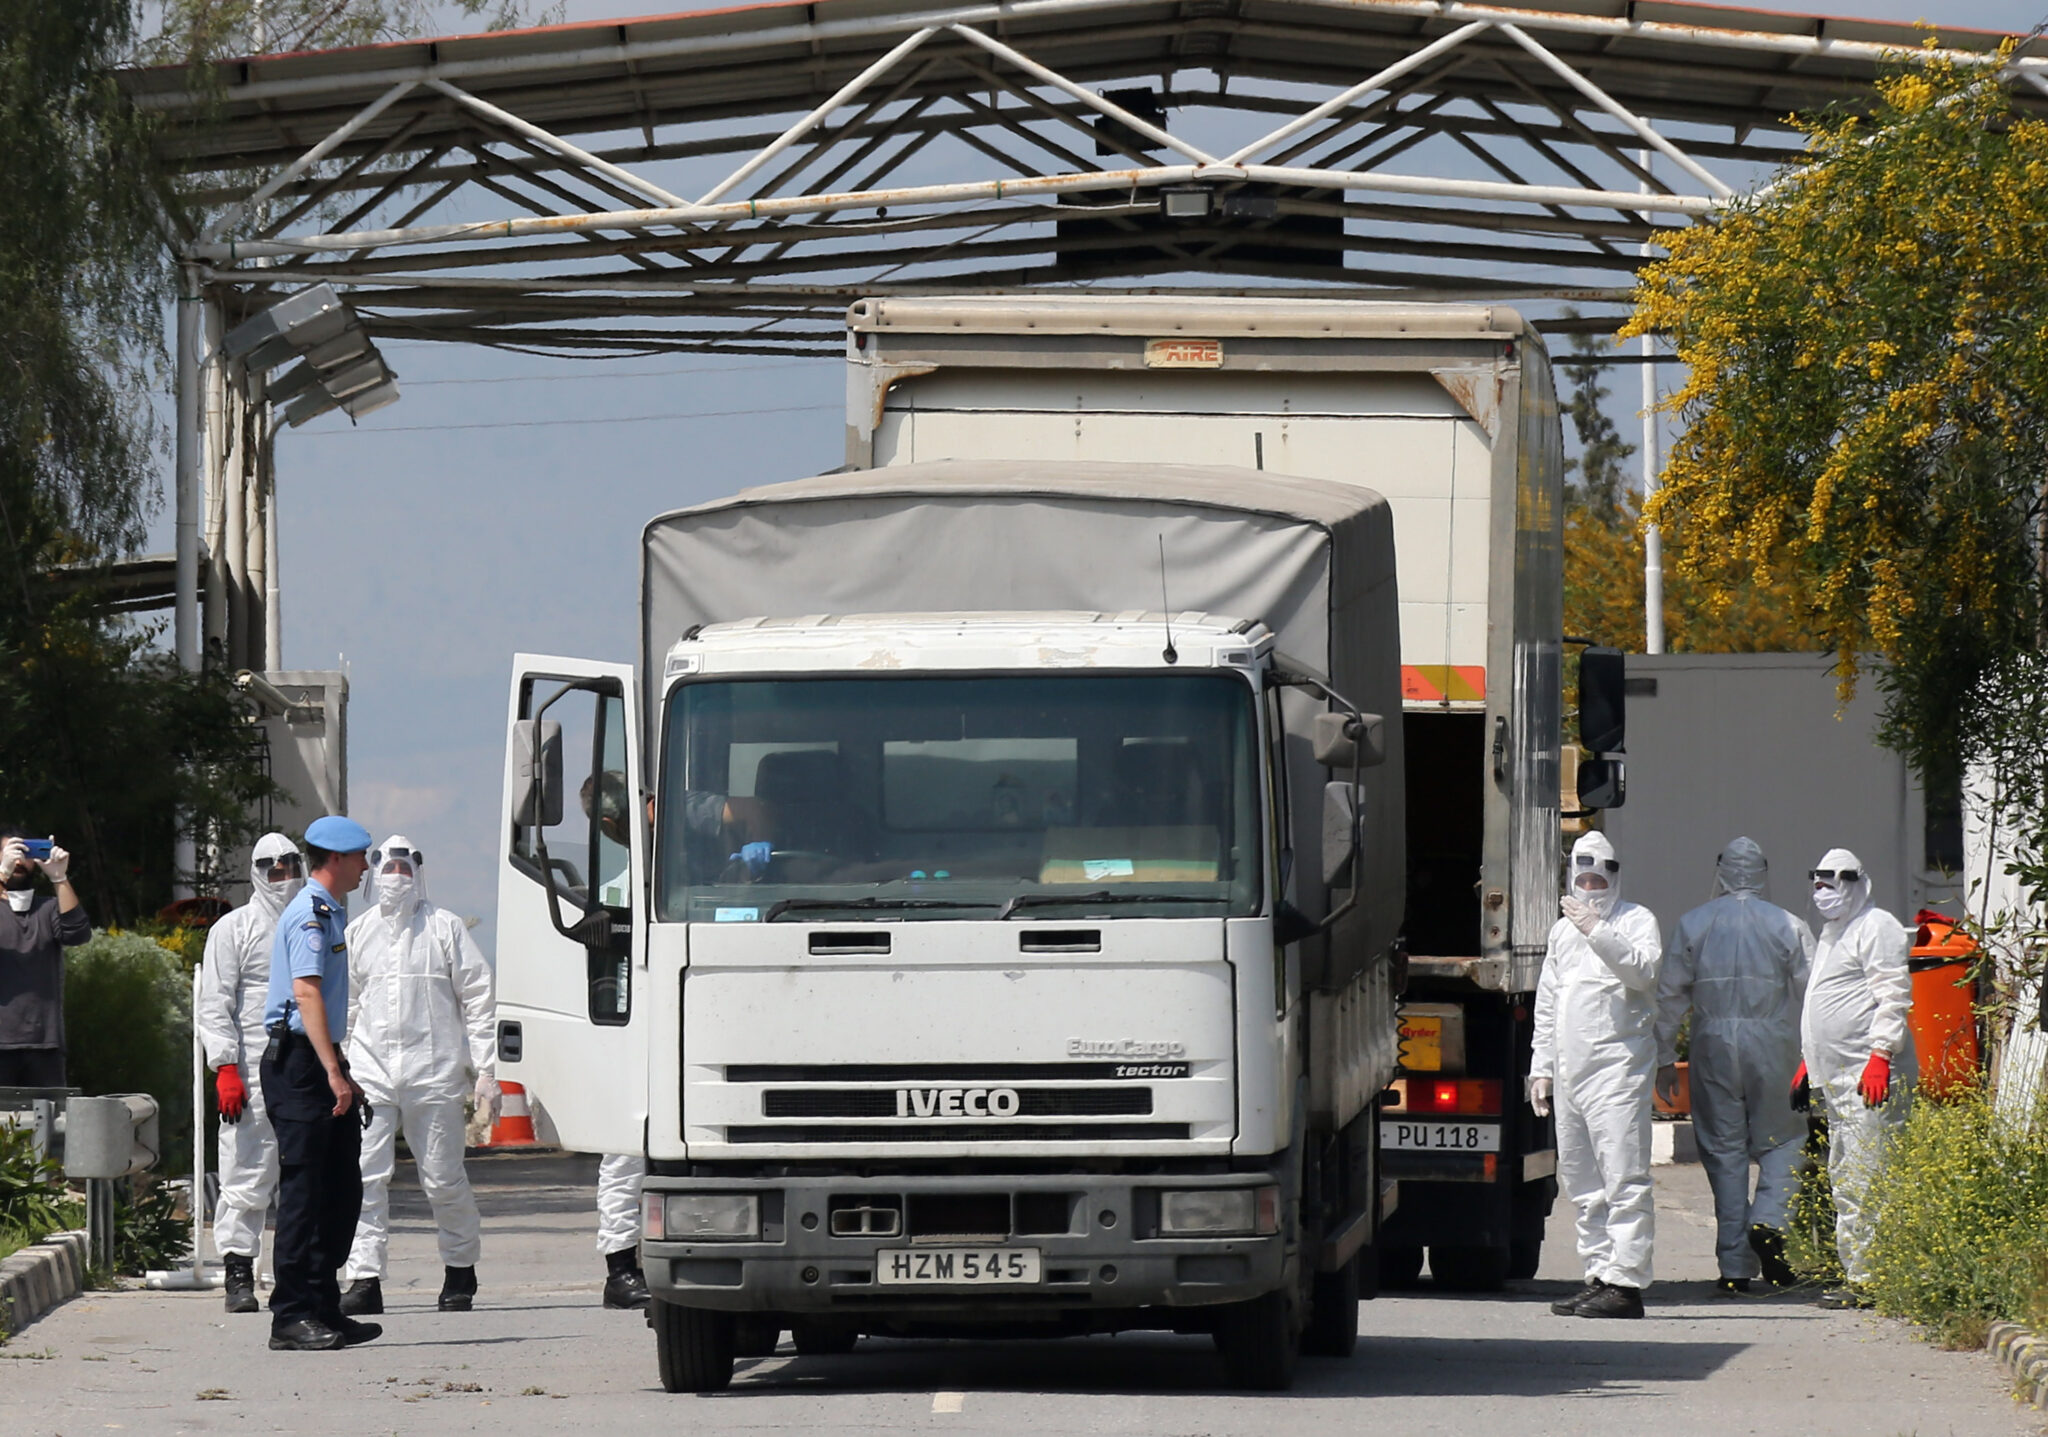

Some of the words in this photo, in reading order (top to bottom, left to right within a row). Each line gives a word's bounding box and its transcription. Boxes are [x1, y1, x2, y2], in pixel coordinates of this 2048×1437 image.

[1116, 1064, 1186, 1077] tector
[896, 1088, 1020, 1117] IVECO
[1398, 1126, 1428, 1147] PU
[1435, 1127, 1479, 1148] 118
[894, 1254, 954, 1278] HZM
[963, 1253, 1024, 1278] 545
